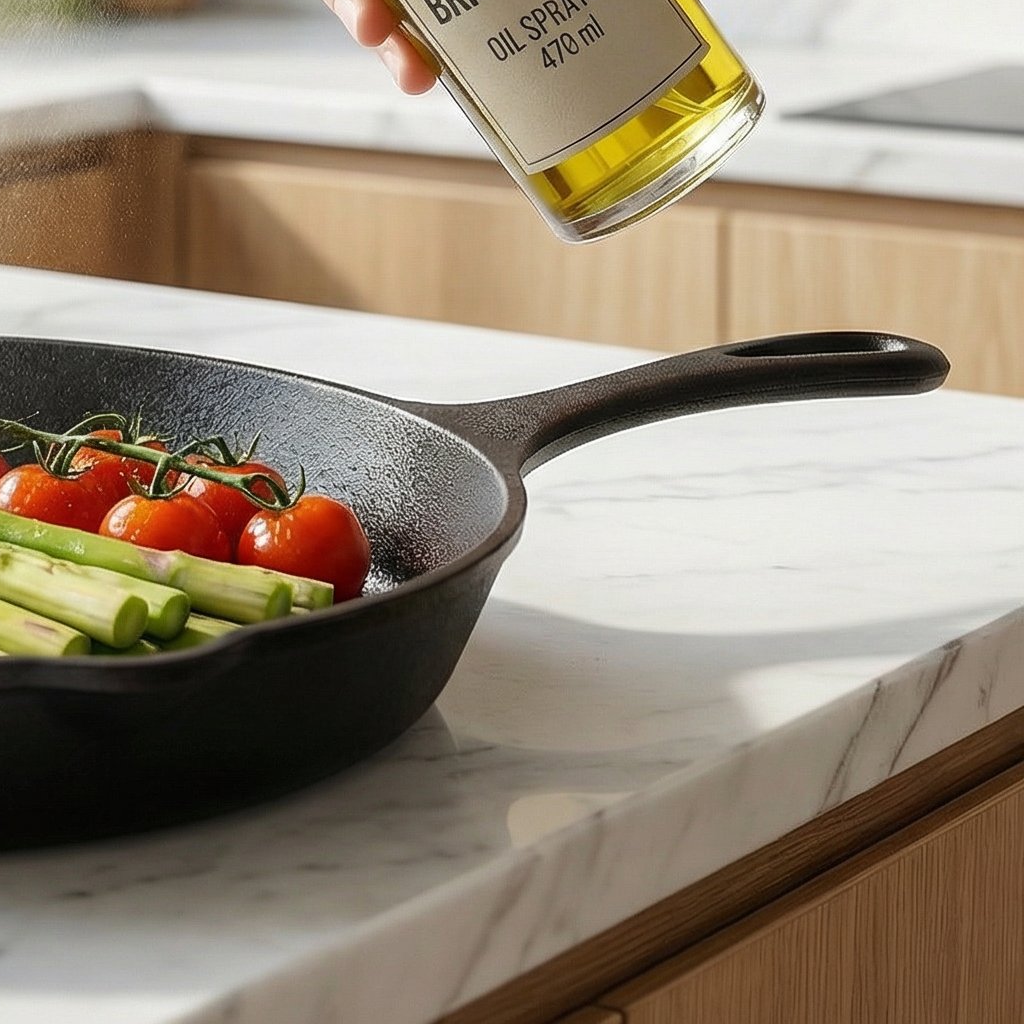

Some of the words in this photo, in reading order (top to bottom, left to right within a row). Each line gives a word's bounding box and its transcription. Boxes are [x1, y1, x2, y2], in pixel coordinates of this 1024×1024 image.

[487, 27, 527, 62] OIL
[541, 32, 579, 69] 470
[577, 14, 605, 47] ml
